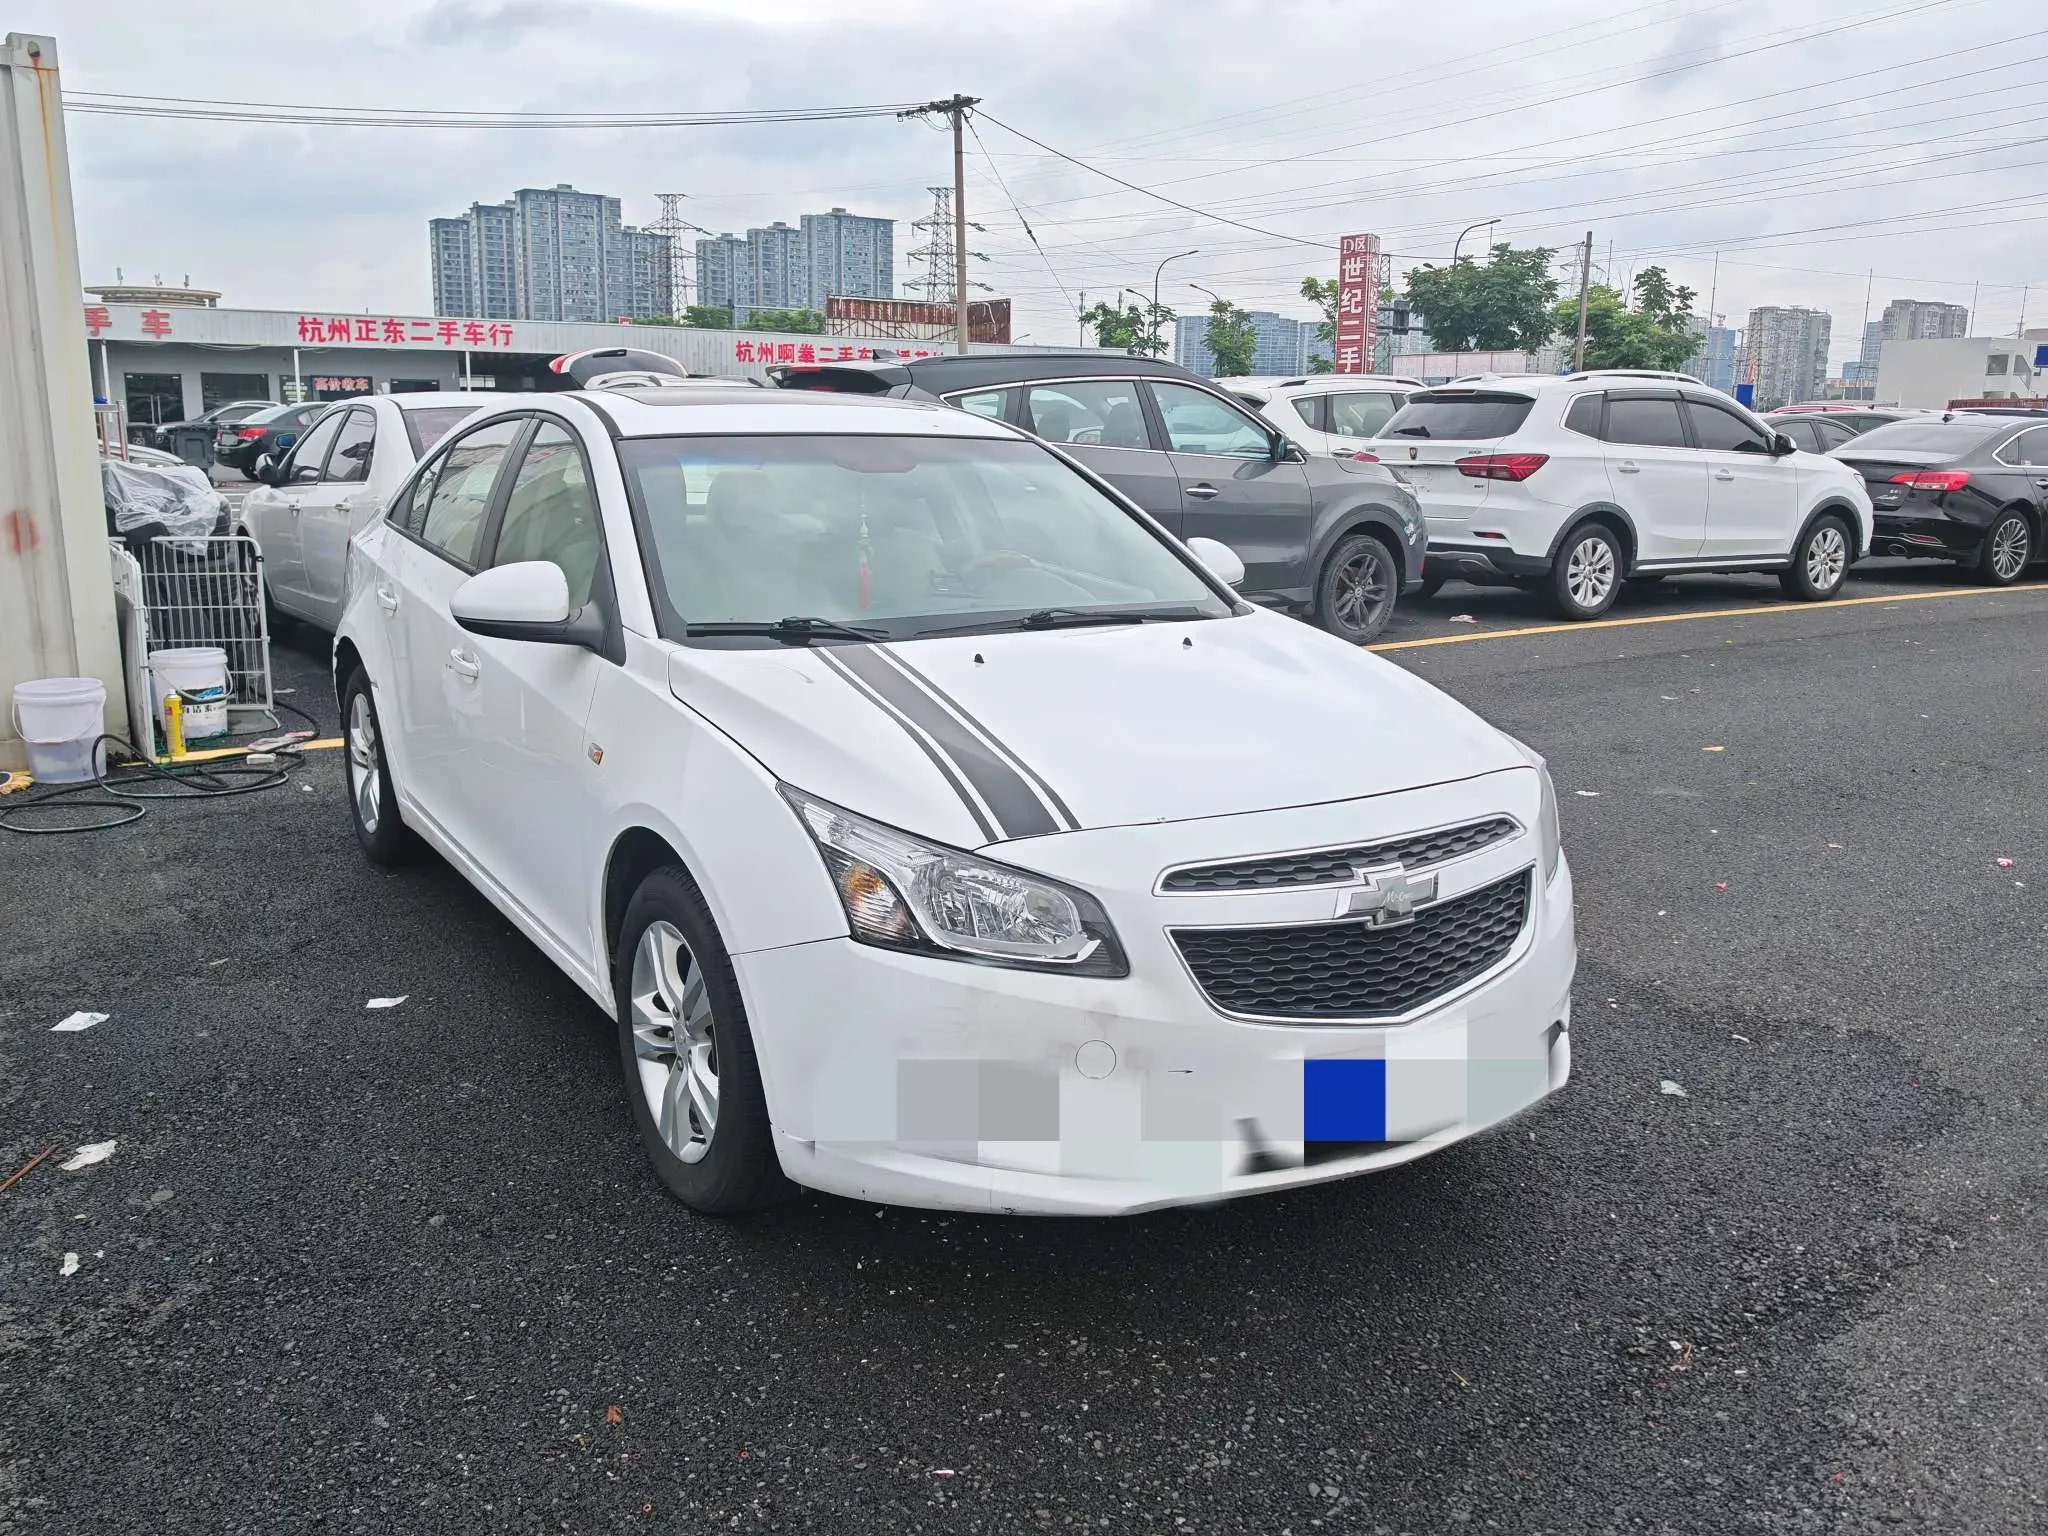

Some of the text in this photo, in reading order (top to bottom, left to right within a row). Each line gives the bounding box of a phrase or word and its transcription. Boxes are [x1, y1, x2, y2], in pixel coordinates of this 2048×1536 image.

[298, 316, 513, 347] 杭州正东二手车行
